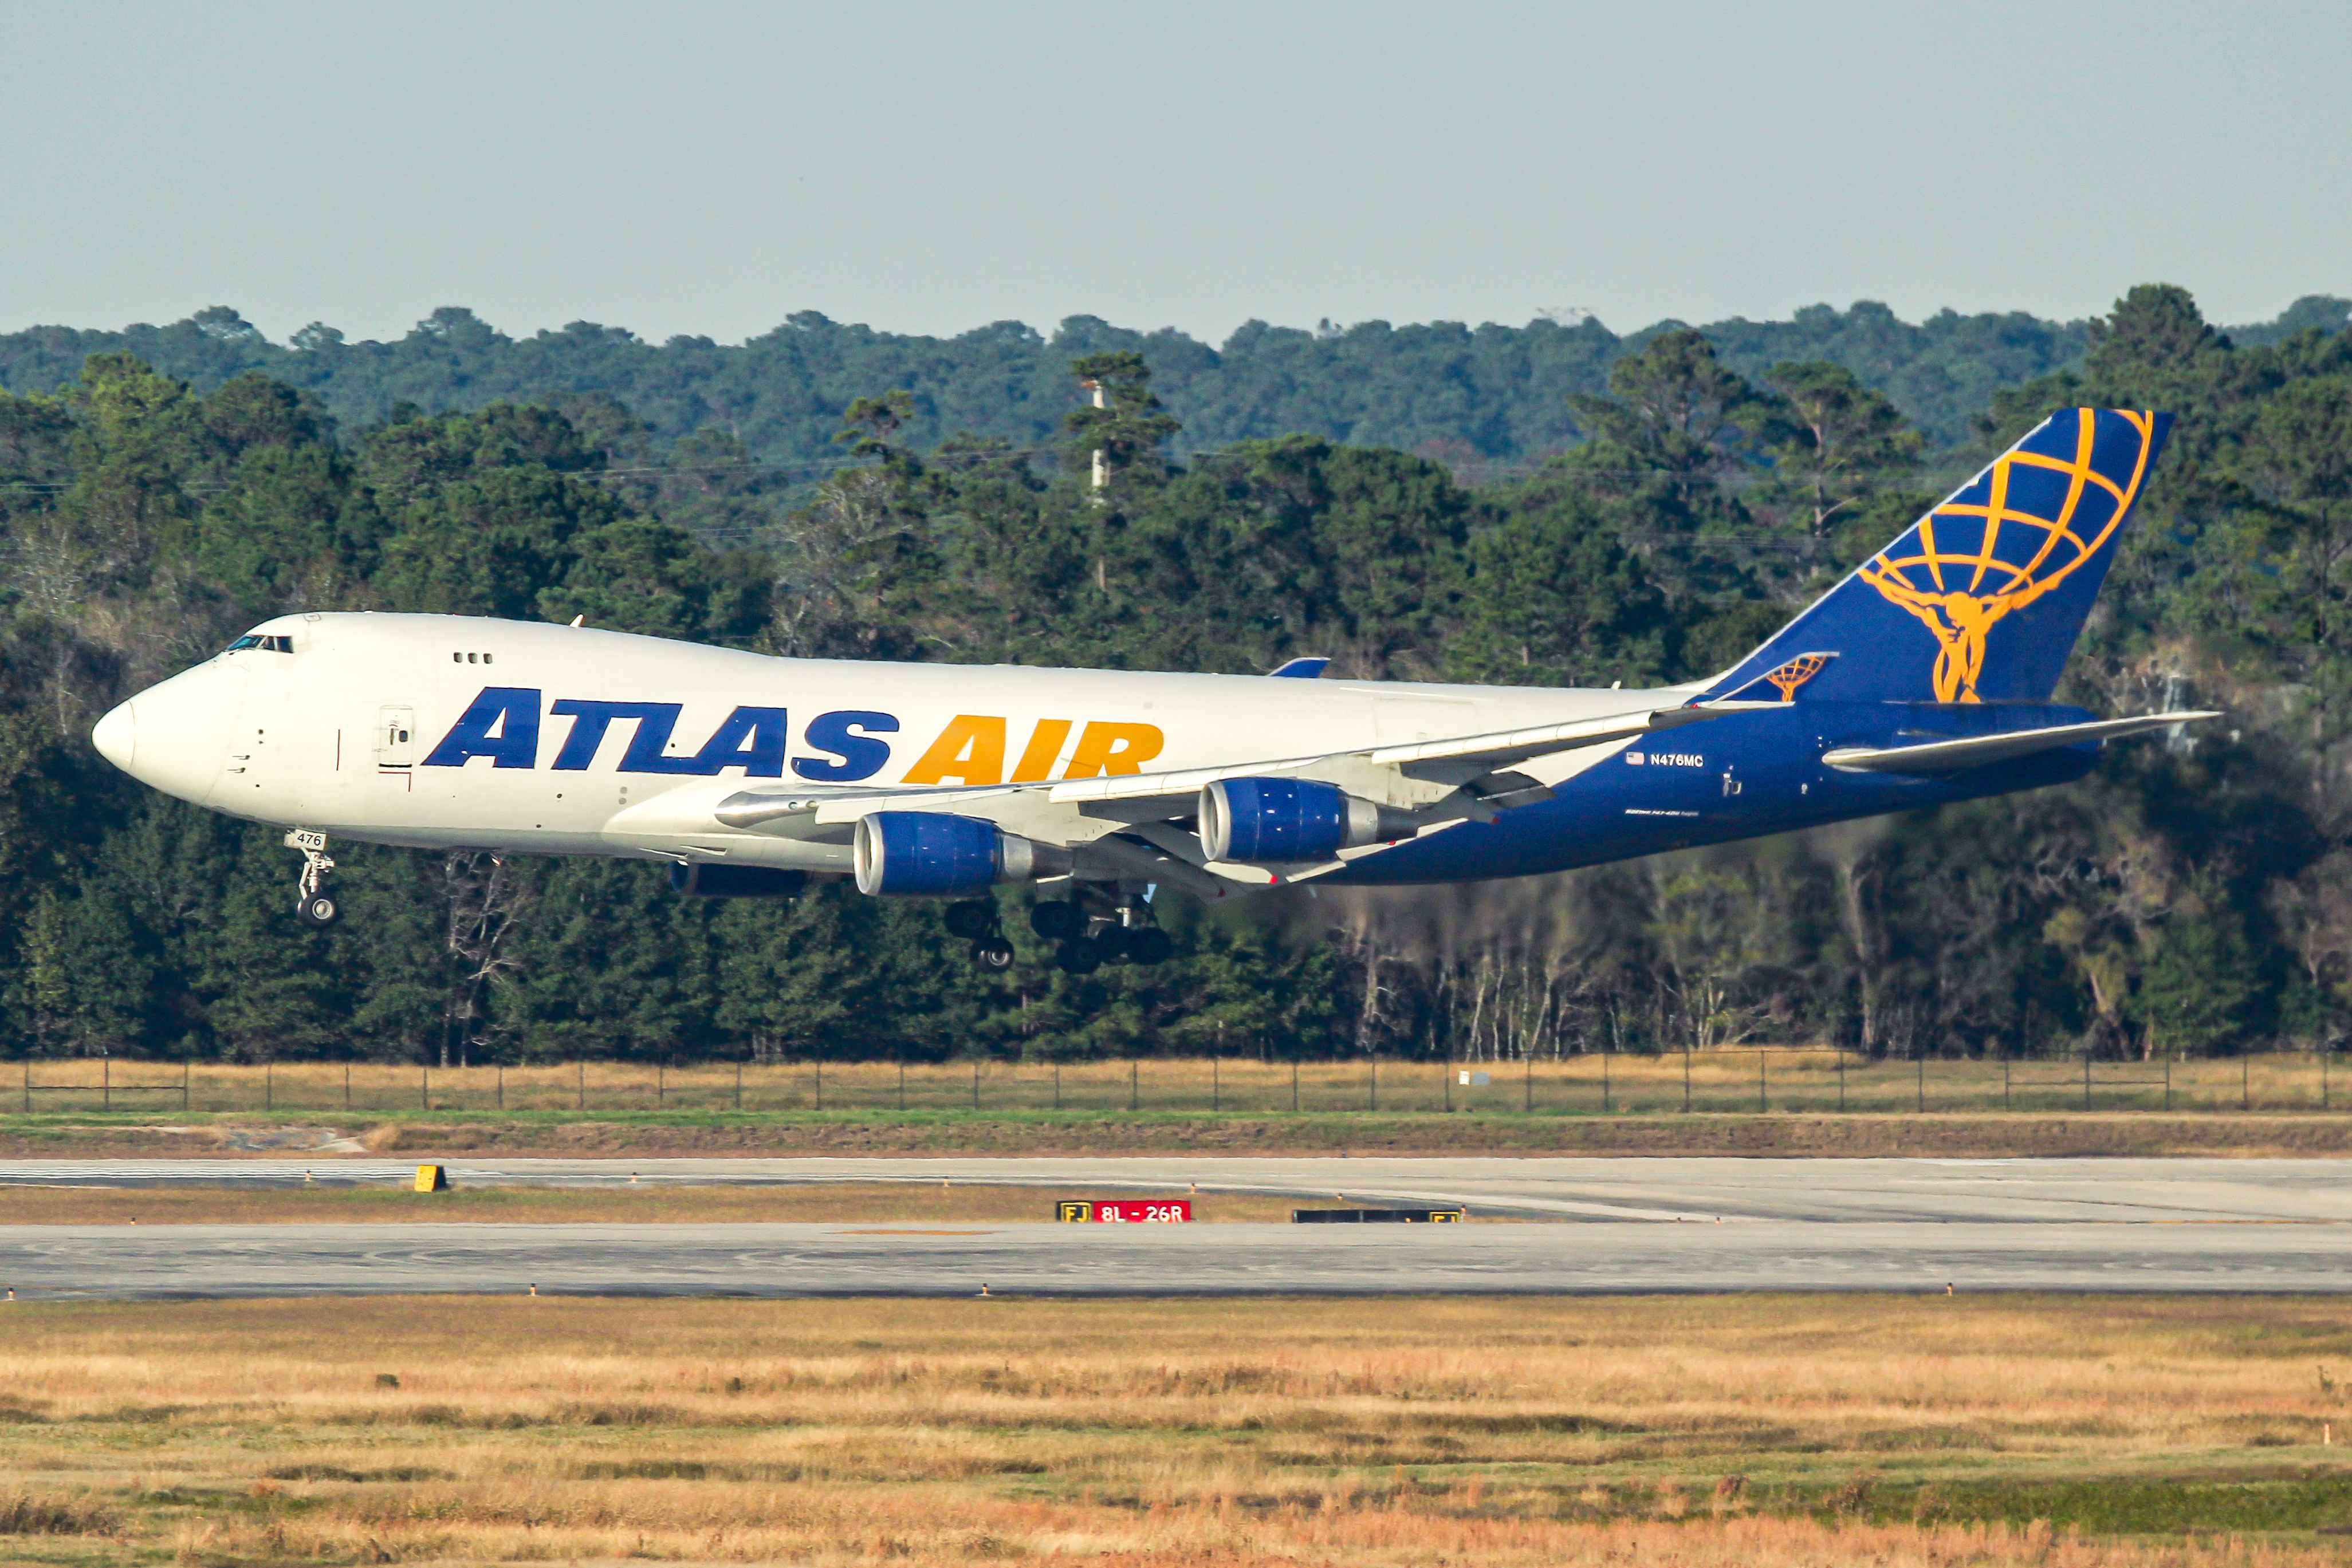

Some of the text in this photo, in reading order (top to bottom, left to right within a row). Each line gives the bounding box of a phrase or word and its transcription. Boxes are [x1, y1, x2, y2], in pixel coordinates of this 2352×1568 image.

[421, 687, 1164, 786] ATLAS AIR
[1650, 754, 1704, 767] N476MC
[297, 833, 321, 846] 476
[1065, 1207, 1087, 1222] FJ
[1101, 1206, 1126, 1222] 8L
[1146, 1205, 1183, 1222] 26R
